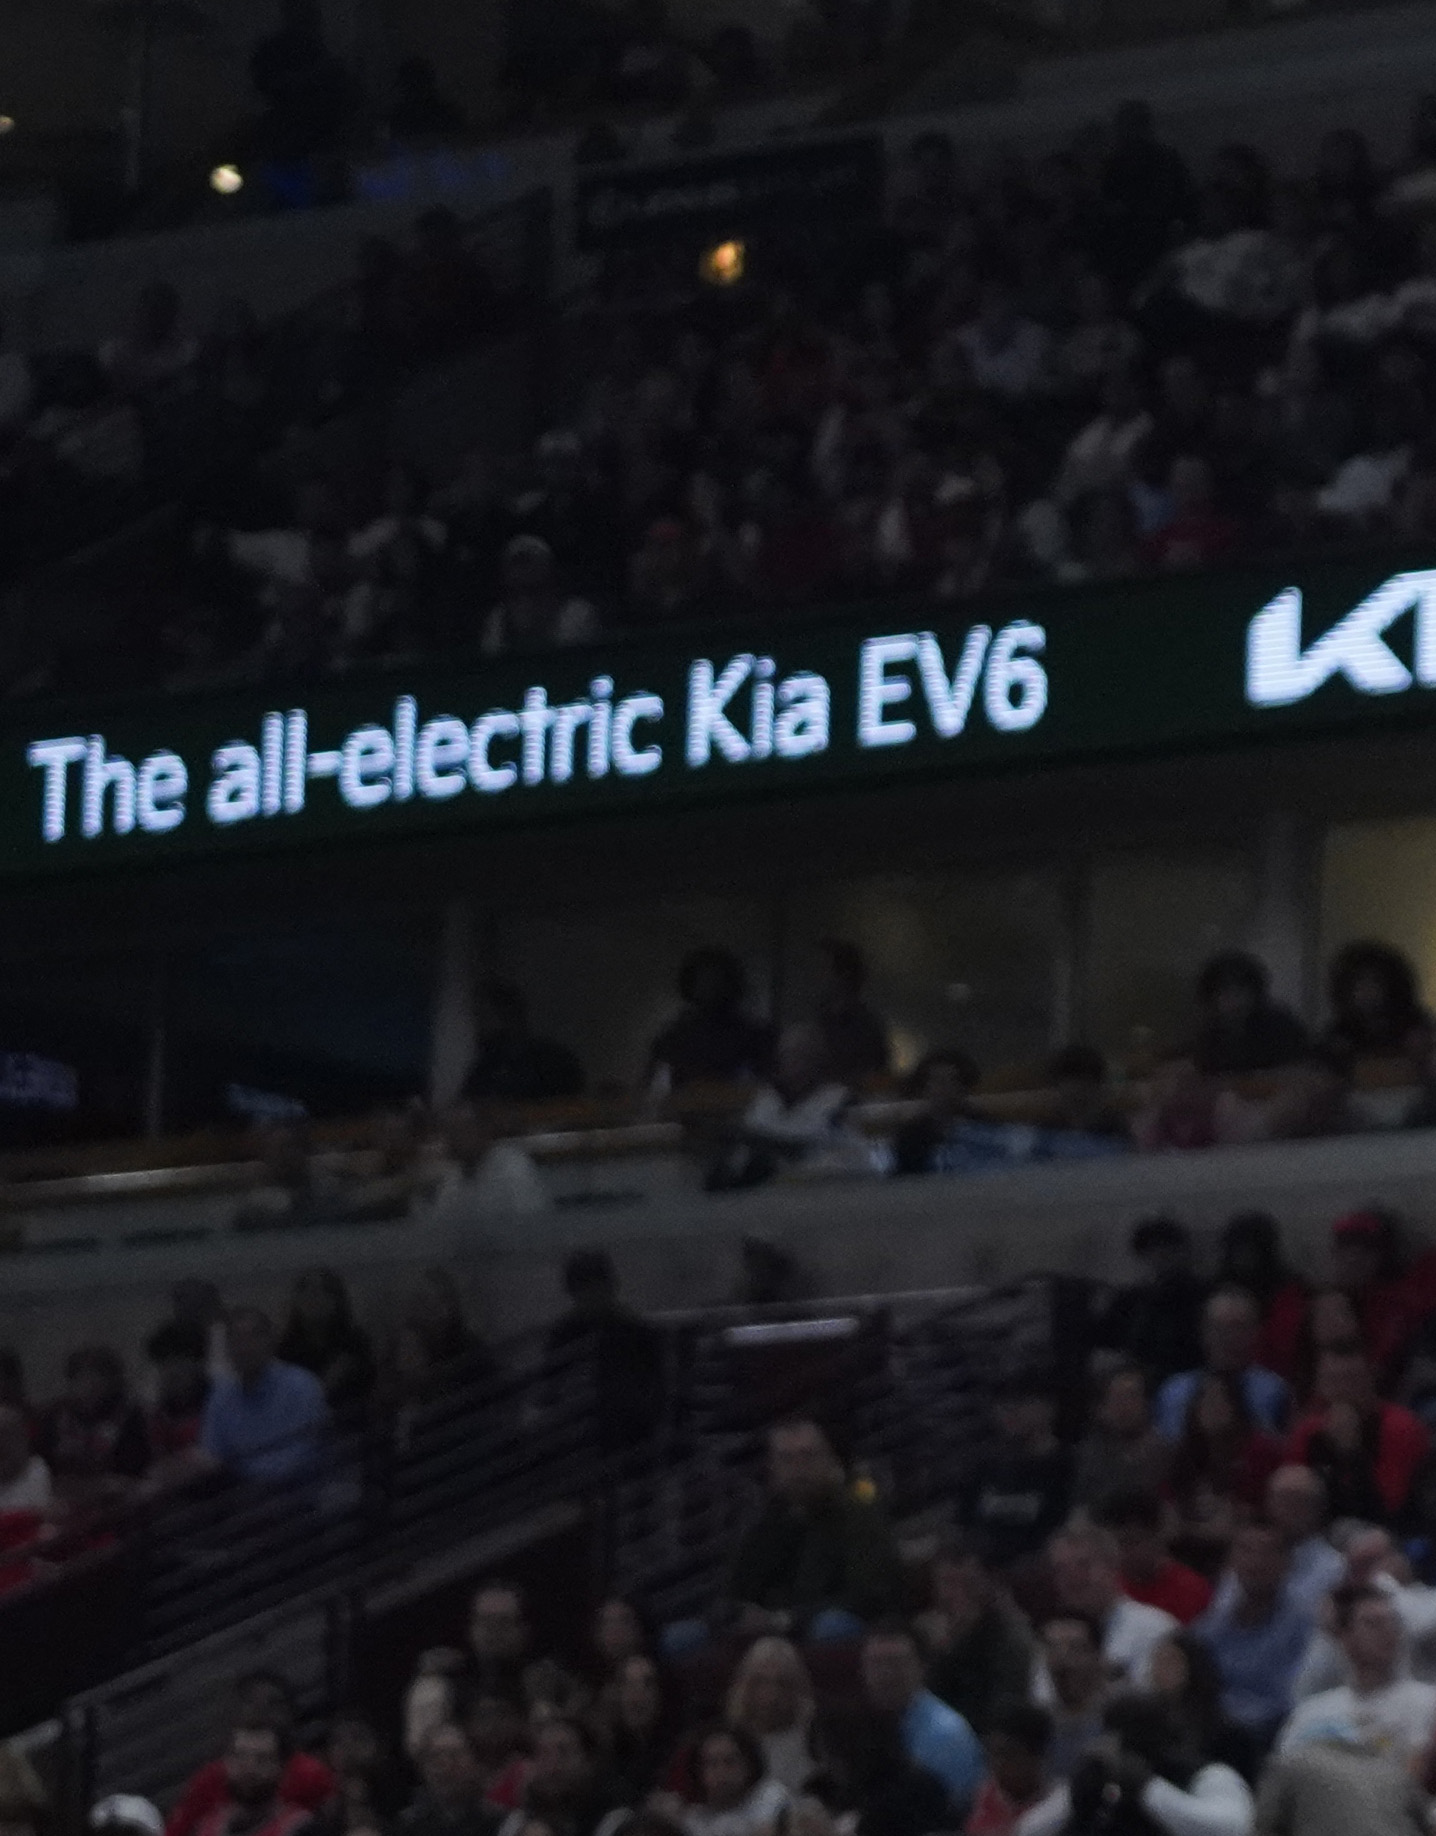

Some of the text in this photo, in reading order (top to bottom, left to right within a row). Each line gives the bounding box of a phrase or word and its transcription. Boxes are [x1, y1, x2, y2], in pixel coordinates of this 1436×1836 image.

[30, 619, 1048, 842] The all-electric Kia EV6
